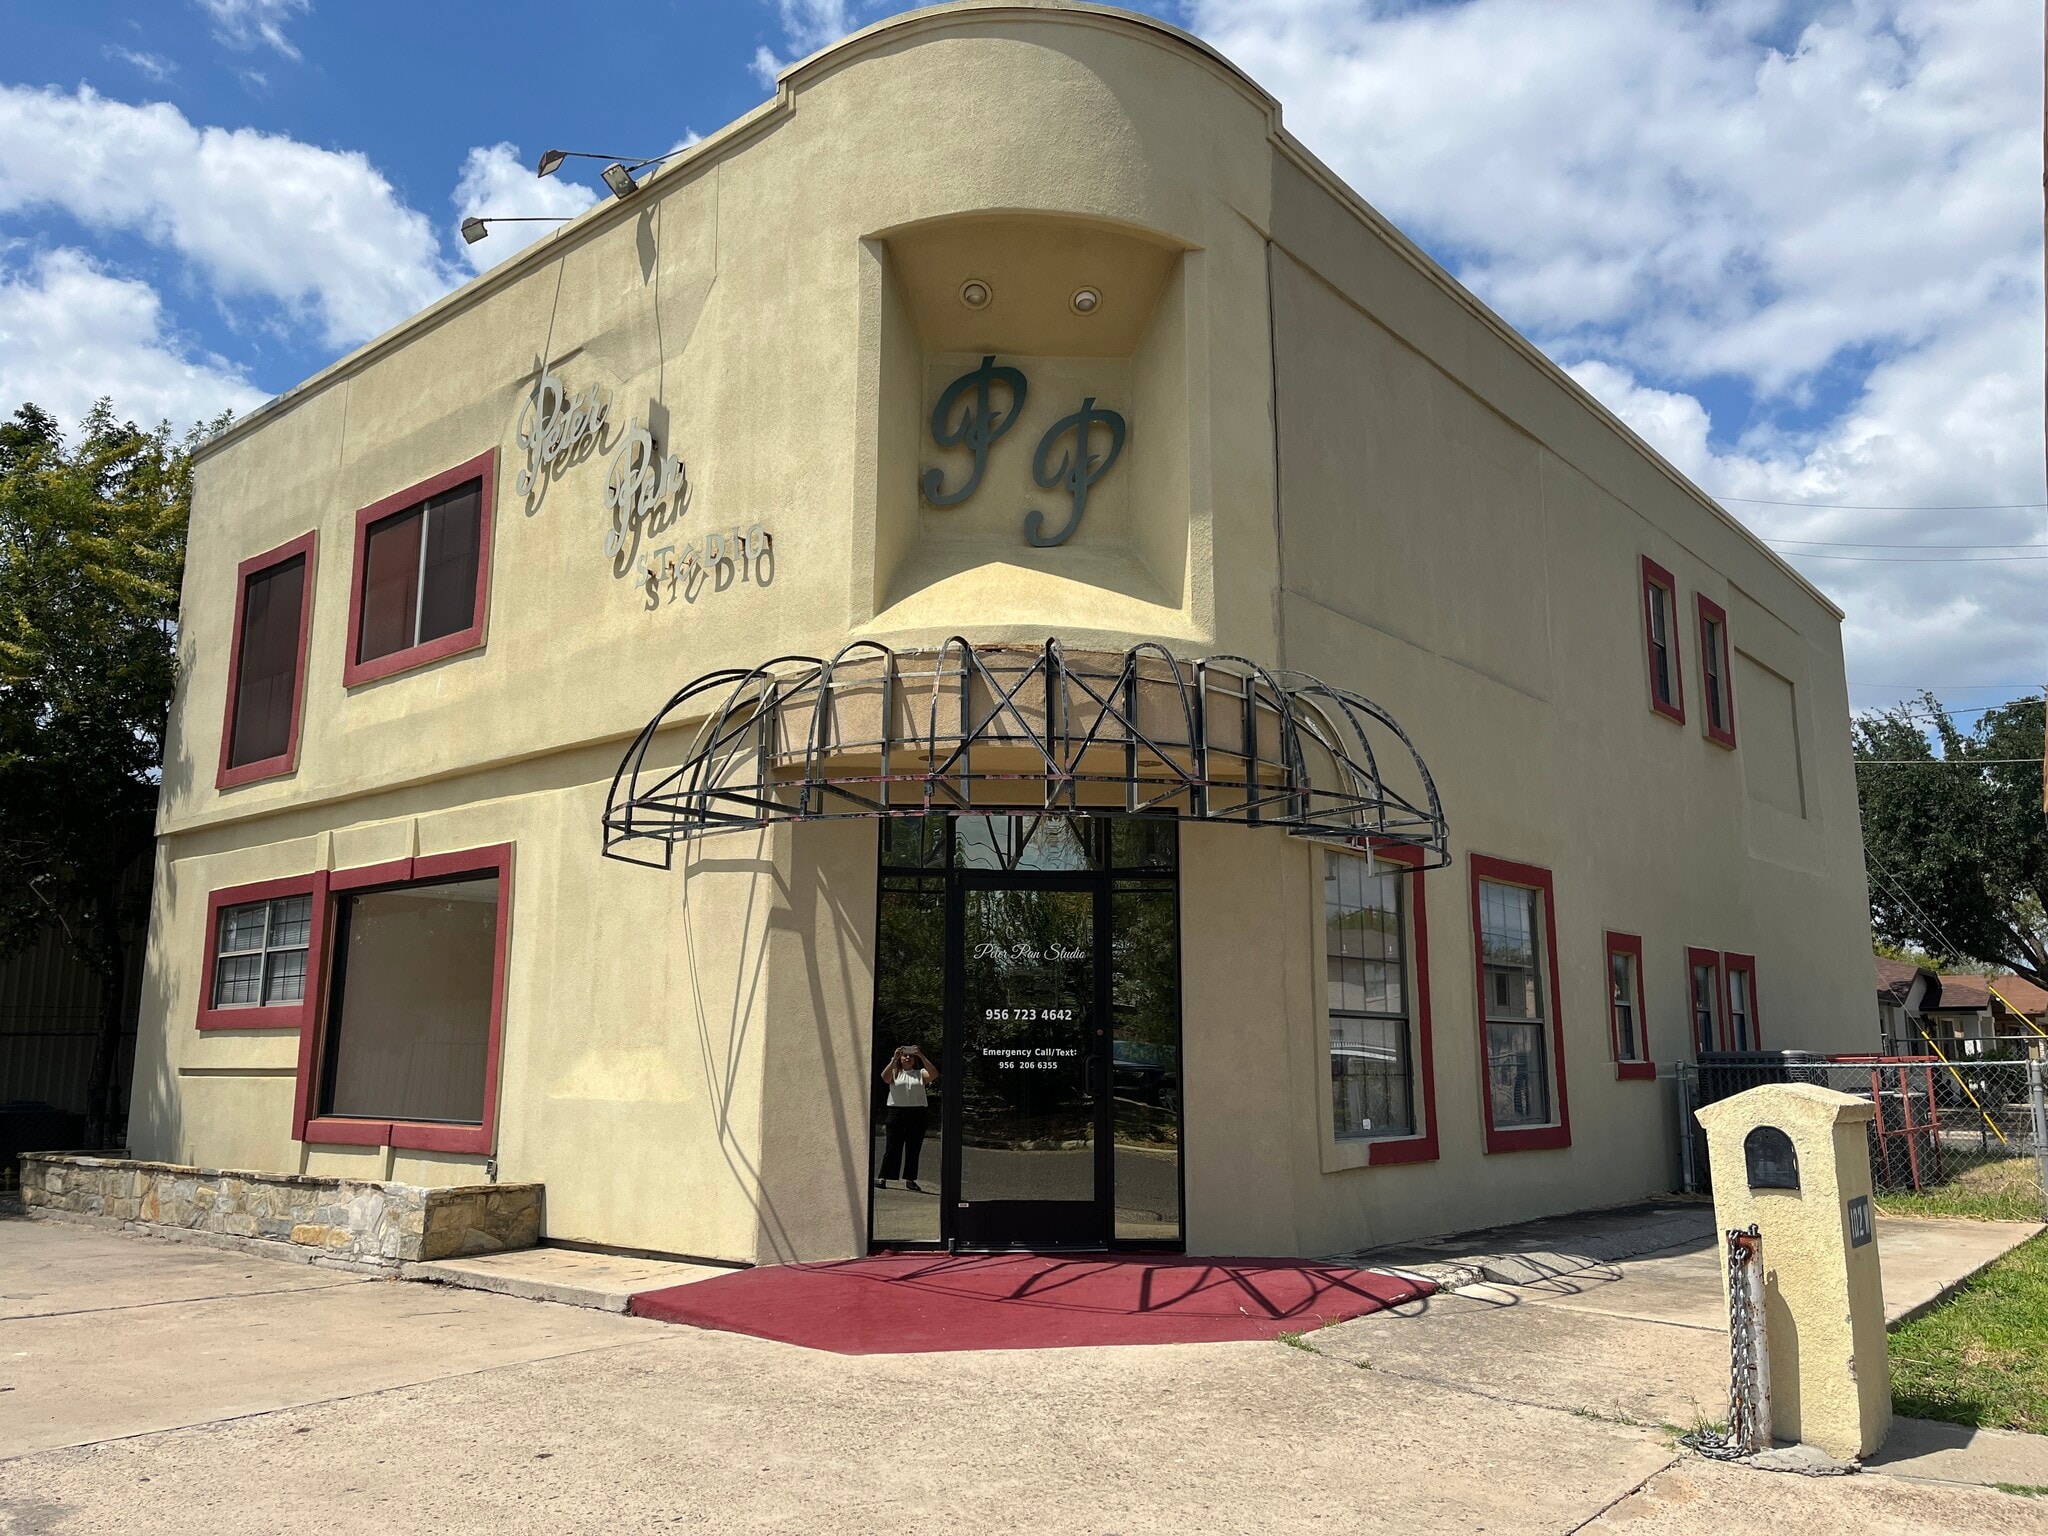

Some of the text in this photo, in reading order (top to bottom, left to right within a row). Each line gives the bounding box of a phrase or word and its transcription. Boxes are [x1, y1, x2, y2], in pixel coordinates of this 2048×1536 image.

[516, 364, 686, 558] Peter Pan
[635, 522, 765, 590] STUDIO
[973, 942, 1086, 961] Peter Pan Studio
[985, 1009, 1072, 1021] 956 723 4642
[982, 1048, 1078, 1058] Emergency Call/Text:
[999, 1061, 1058, 1070] 956 206 6355
